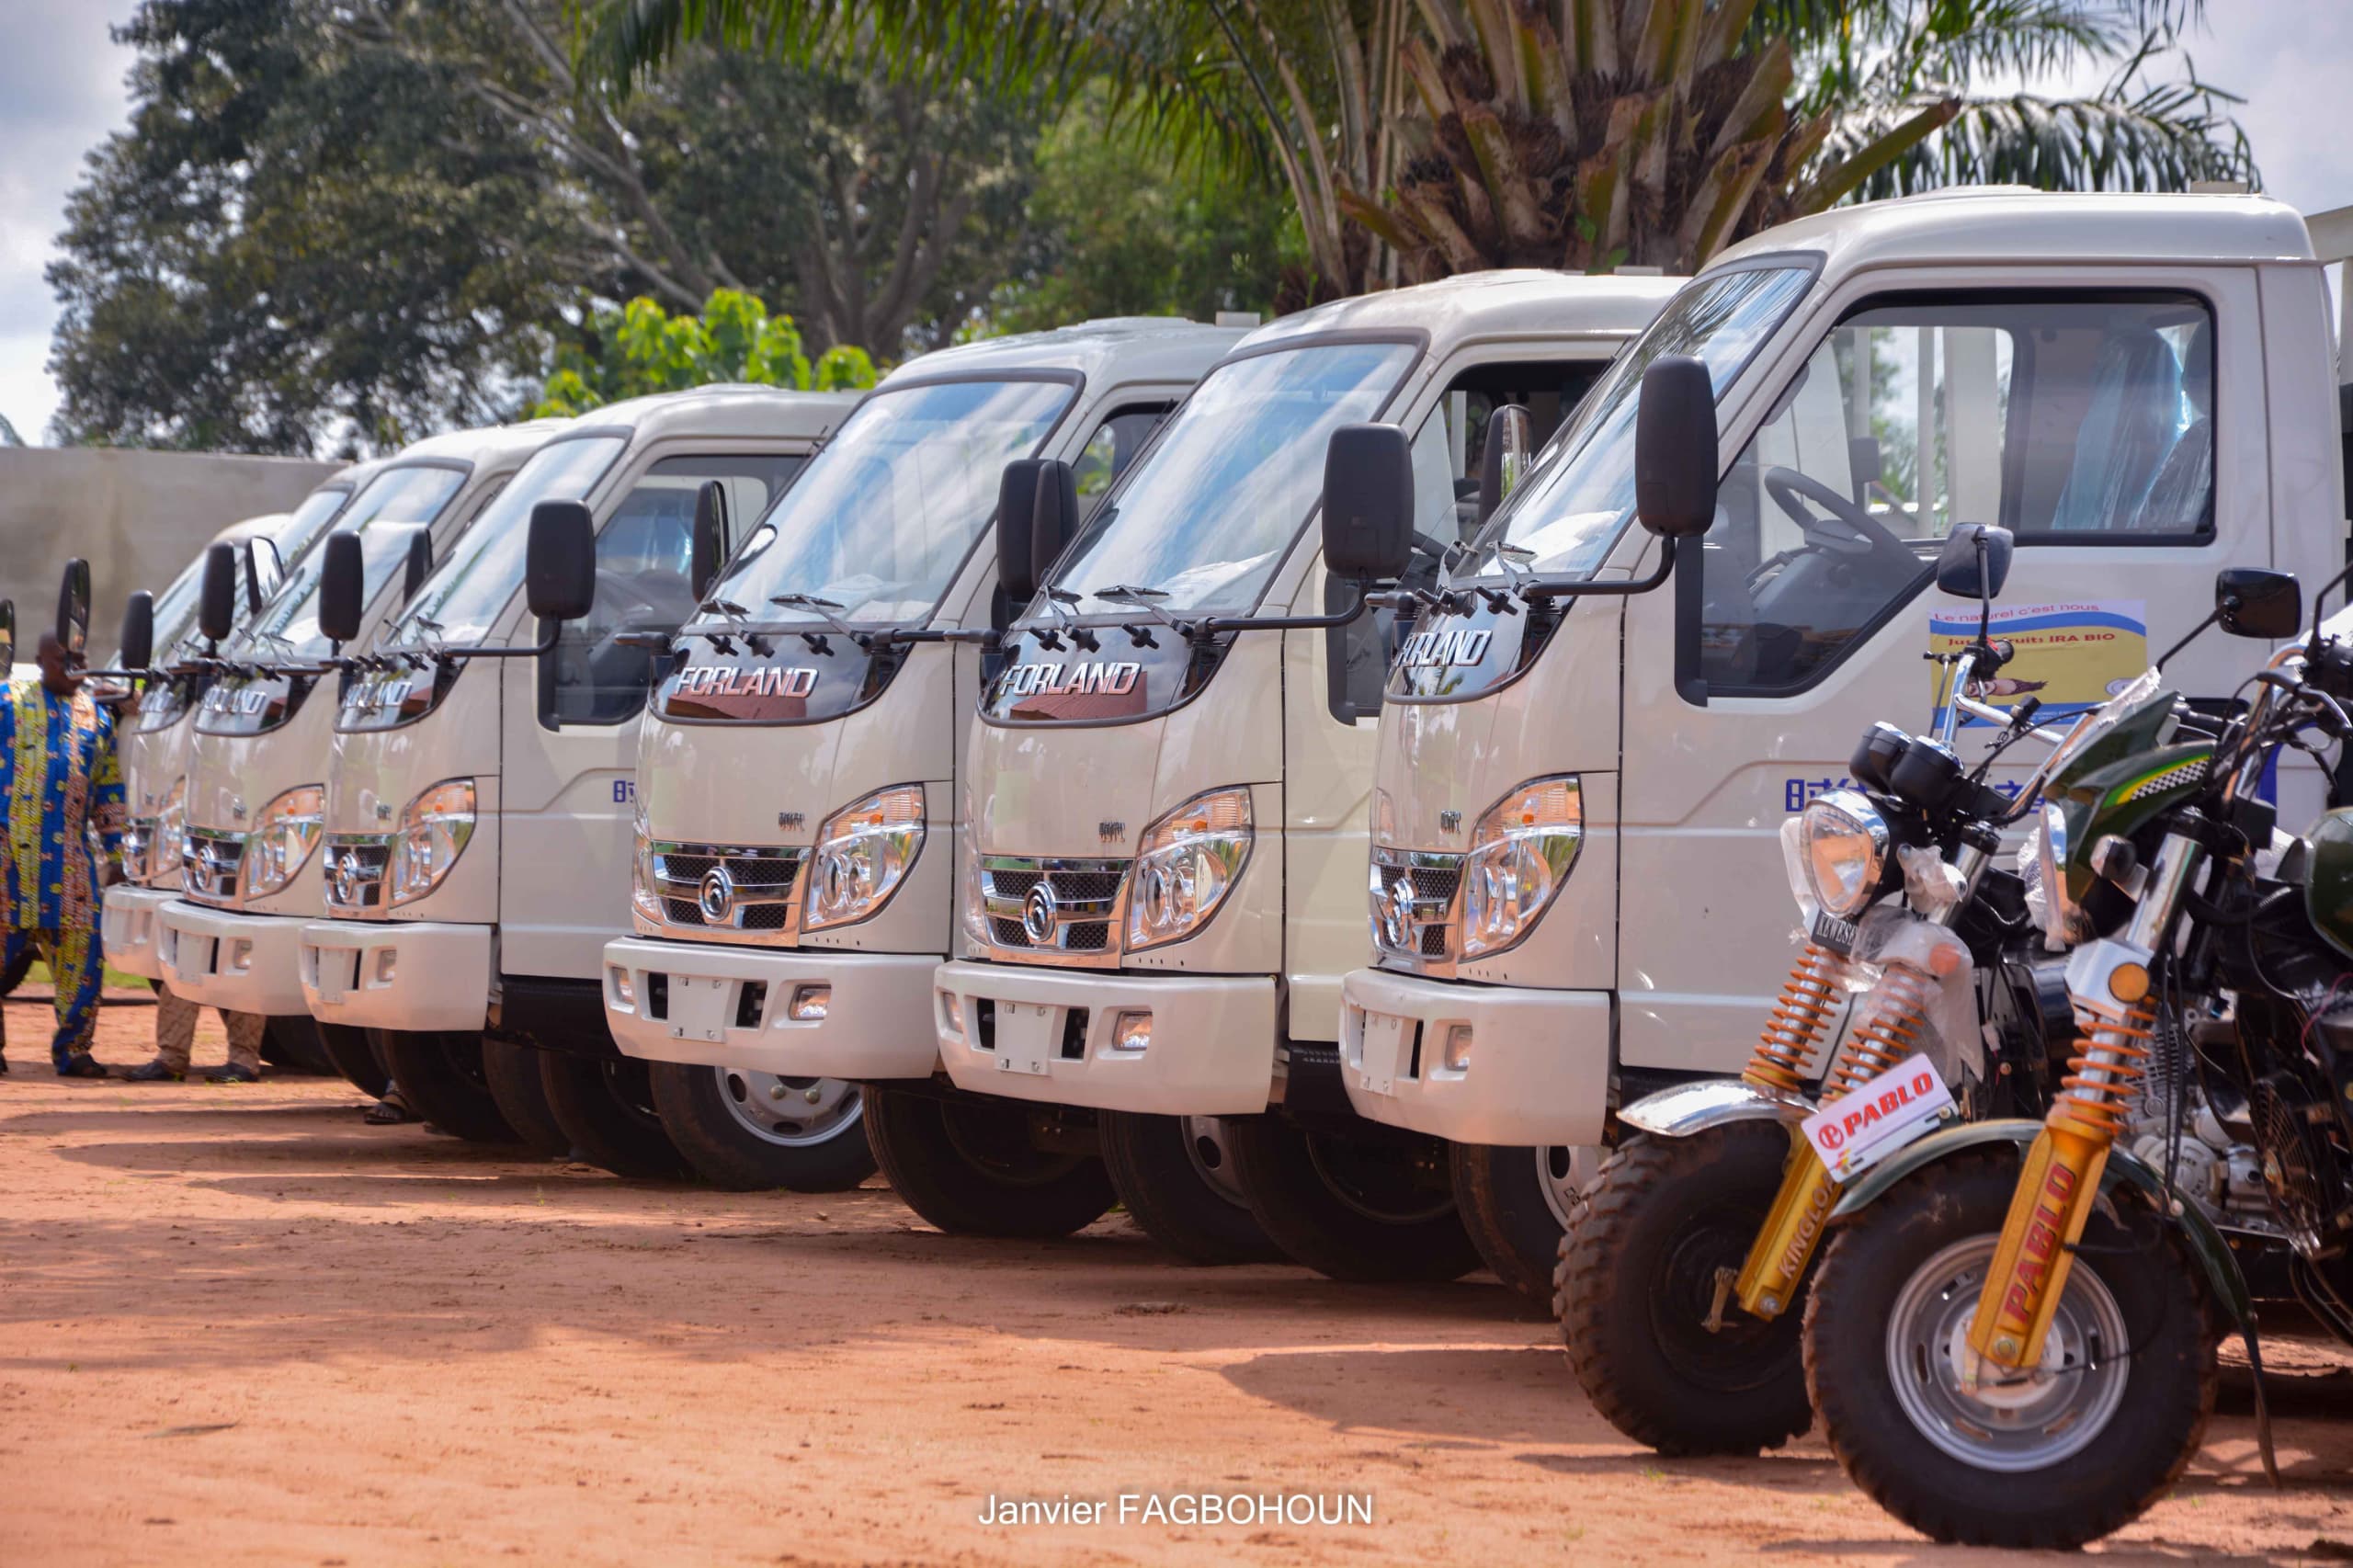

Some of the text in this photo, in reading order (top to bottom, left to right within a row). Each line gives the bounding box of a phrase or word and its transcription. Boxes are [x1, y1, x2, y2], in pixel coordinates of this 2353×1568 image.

[2060, 603, 2099, 611] nous
[2049, 634, 2079, 643] IRA
[2084, 632, 2115, 642] BIO
[676, 666, 819, 699] FORLAND
[1000, 662, 1142, 696] FORLAND
[1843, 1072, 1934, 1138] PABLO
[2004, 1162, 2077, 1324] PABLO
